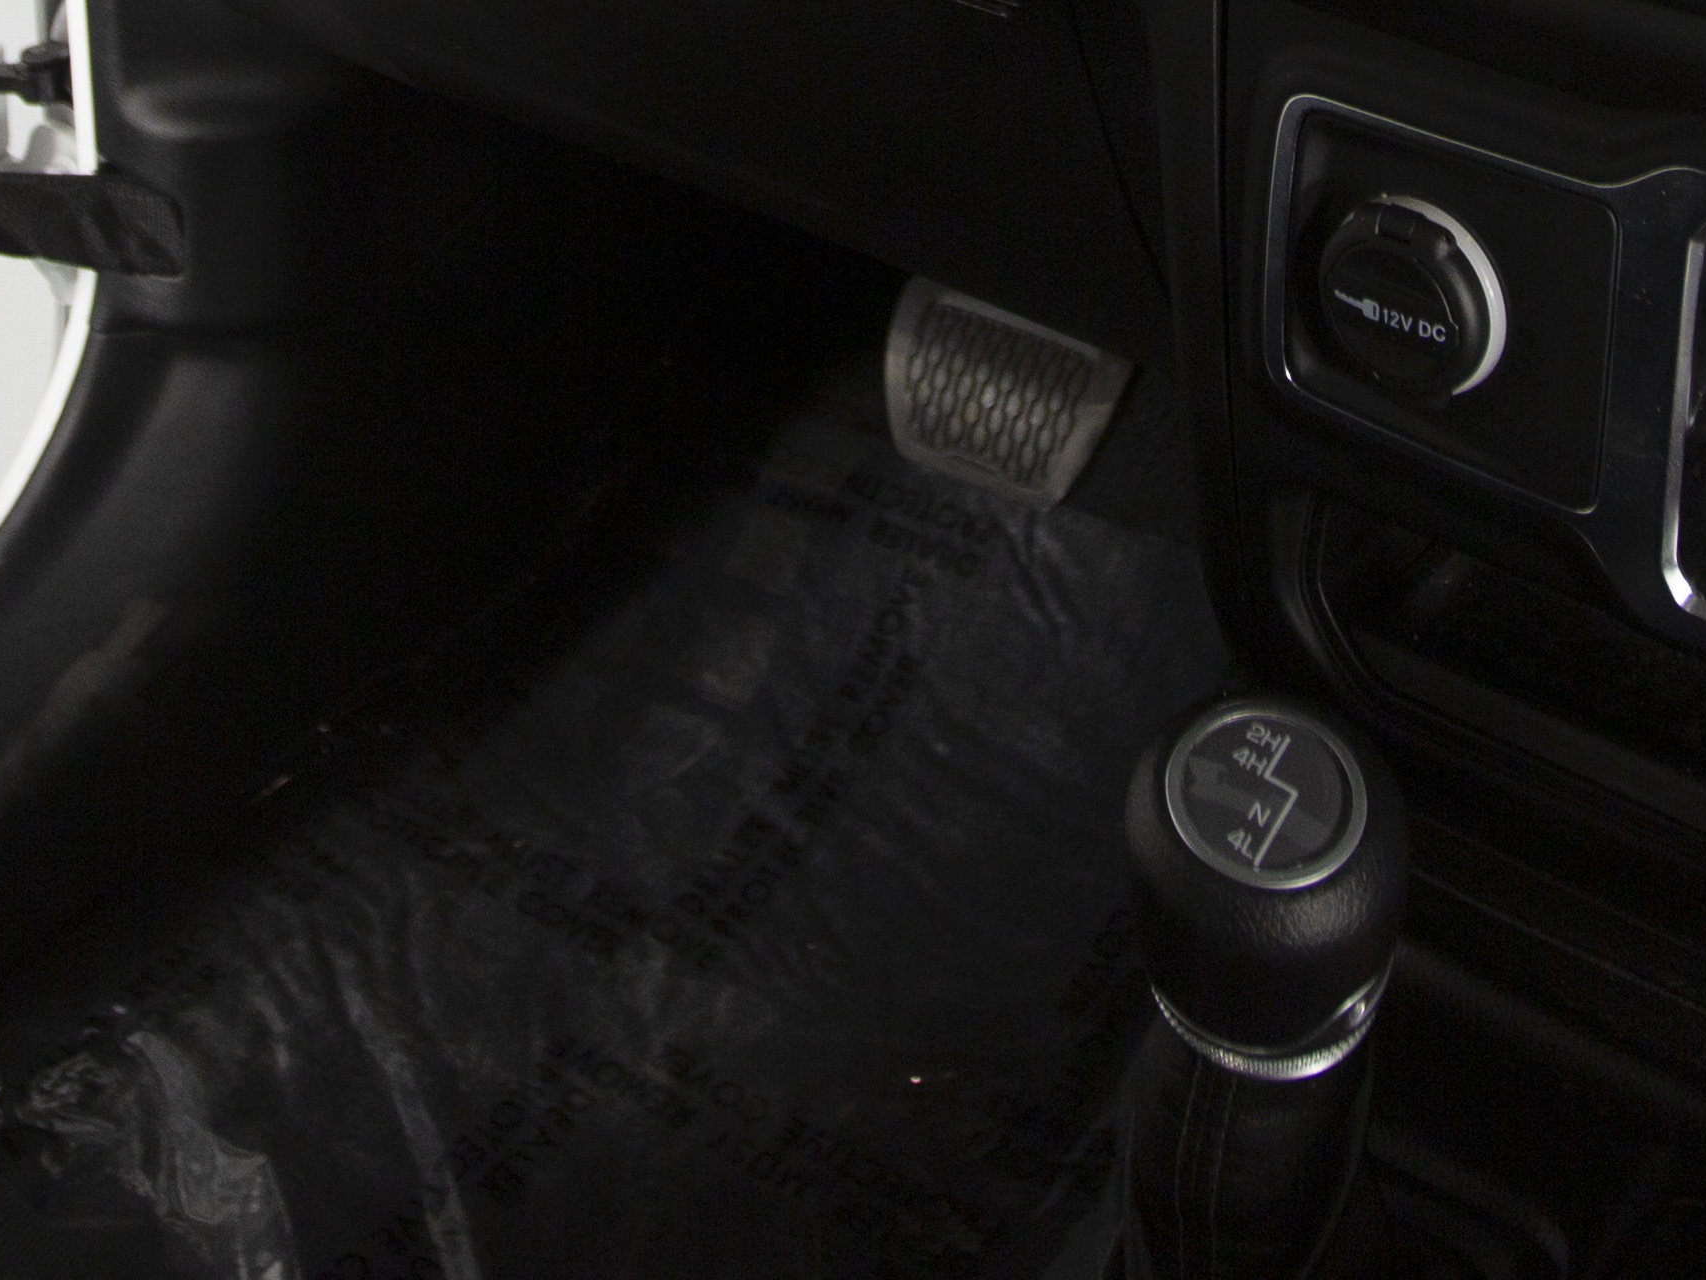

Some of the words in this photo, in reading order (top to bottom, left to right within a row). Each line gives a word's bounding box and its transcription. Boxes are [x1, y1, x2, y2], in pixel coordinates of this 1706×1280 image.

[1382, 308, 1413, 332] 12V
[1418, 319, 1446, 342] DC
[1245, 721, 1281, 753] 2H
[1232, 746, 1268, 777] 4H
[1247, 800, 1271, 829] N
[1227, 827, 1253, 860] 4L
